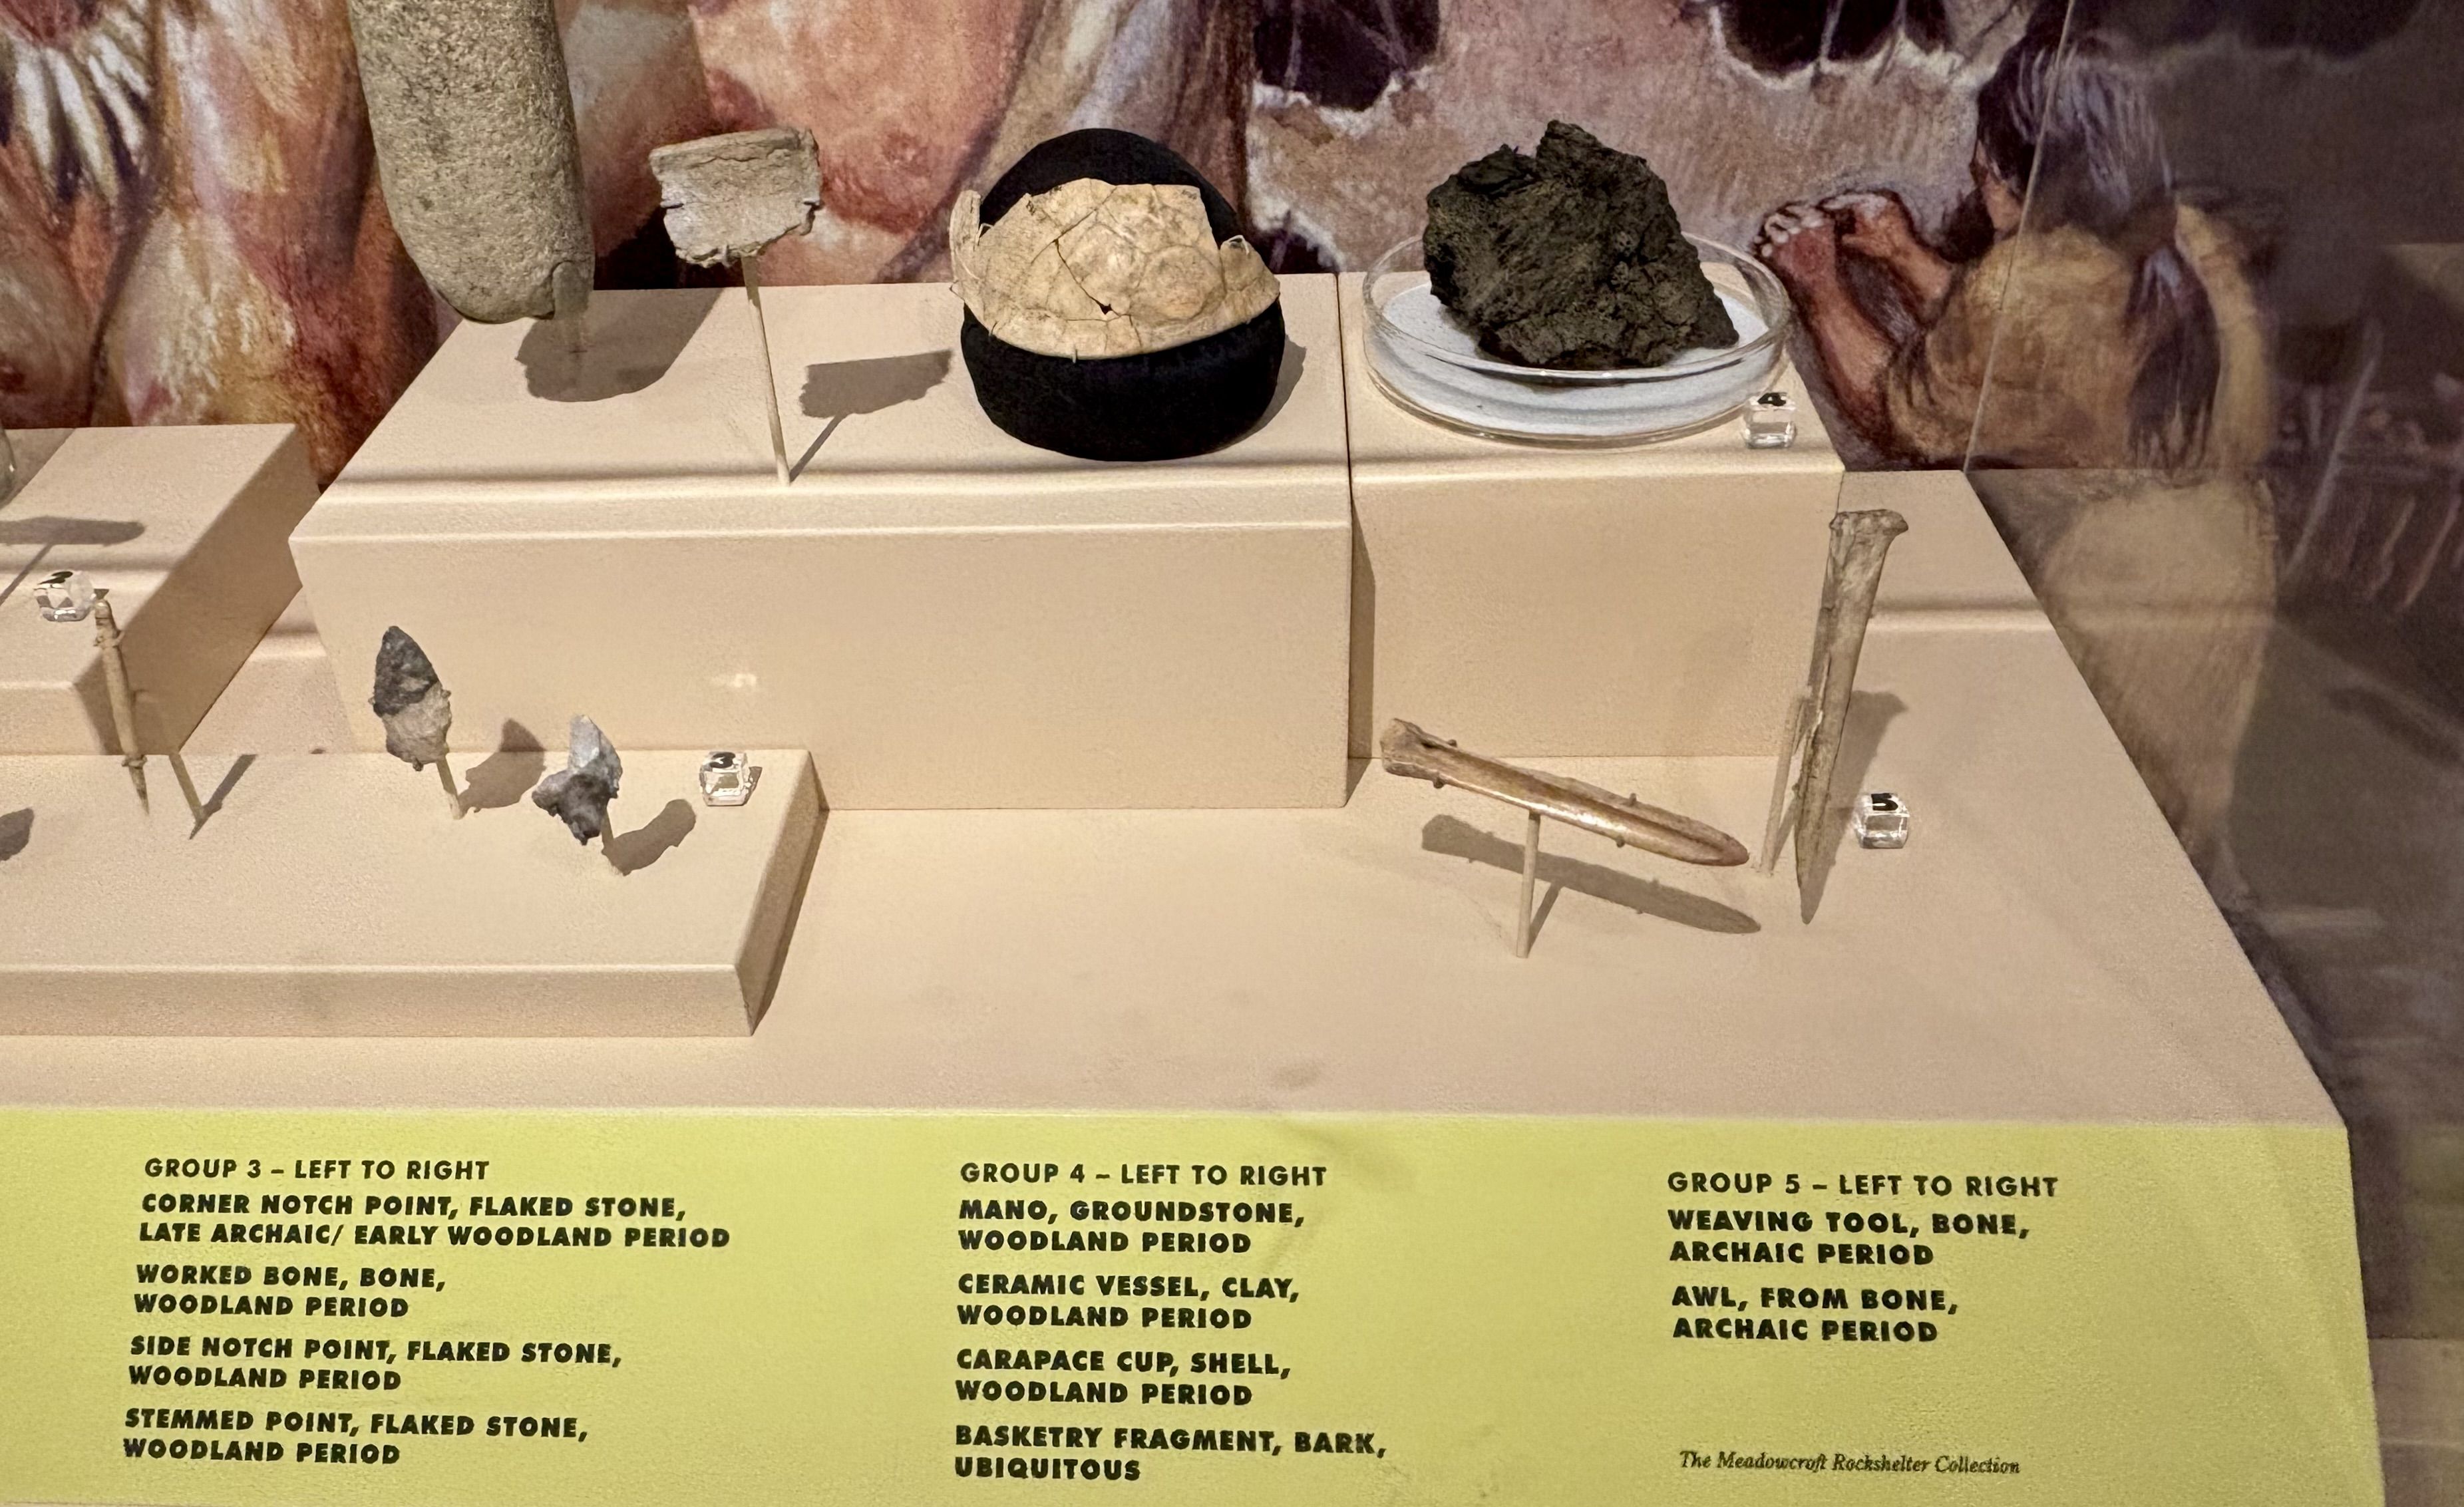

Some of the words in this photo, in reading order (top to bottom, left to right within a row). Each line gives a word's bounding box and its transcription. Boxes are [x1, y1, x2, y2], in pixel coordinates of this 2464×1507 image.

[1757, 392, 1787, 407] 4
[709, 752, 736, 768] 3
[1870, 792, 1898, 811] 5
[145, 1158, 237, 1178] GROUP
[248, 1160, 260, 1178] 3
[295, 1160, 351, 1178] LEFT
[362, 1160, 395, 1179] TO
[407, 1160, 489, 1180] RIGHT
[961, 1163, 1058, 1183] GROUP
[1070, 1164, 1085, 1183] 4
[1122, 1164, 1180, 1184] LEFT
[1192, 1165, 1227, 1185] TO
[1240, 1166, 1326, 1186] RIGHT
[1668, 1172, 1771, 1193] GROUP
[1786, 1174, 1800, 1194] 5
[1840, 1175, 1902, 1195] LEFT
[1914, 1176, 1952, 1196] TO
[1966, 1176, 2058, 1197] RIGHT
[142, 1194, 249, 1213] CORNER
[261, 1195, 352, 1214] NOTCH
[365, 1196, 458, 1220] POINT,
[470, 1197, 572, 1216] FLAKED
[585, 1198, 685, 1221] STONE,
[960, 1200, 1057, 1224] MANO,
[1071, 1200, 1304, 1228] GROUNDSTONE,
[140, 1222, 200, 1242] LATE
[211, 1224, 343, 1246] ARCHAIC/
[355, 1226, 438, 1245] EARLY
[448, 1226, 612, 1246] WOODLAND
[625, 1228, 729, 1248] PERIOD
[1668, 1210, 1813, 1232] WEAVING
[1826, 1212, 1918, 1238] TOOL,
[1932, 1214, 2029, 1239] BONE,
[958, 1230, 1129, 1251] WOODLAND
[1143, 1232, 1250, 1253] PERIOD
[1670, 1241, 1803, 1263] ARCHAIC
[1818, 1244, 1933, 1265] PERIOD
[136, 1264, 252, 1284] WORKED
[264, 1266, 347, 1290] BONE,
[360, 1267, 444, 1291] BONE,
[959, 1273, 1084, 1295] CERAMIC
[1096, 1275, 1209, 1301] VESSEL,
[1222, 1277, 1298, 1303] CLAY,
[134, 1293, 293, 1315] WOODLAND
[306, 1297, 408, 1317] PERIOD
[1672, 1286, 1747, 1311] AWL,
[1761, 1287, 1848, 1309] FROM
[1861, 1289, 1957, 1315] BONE,
[957, 1305, 1128, 1327] WOODLAND
[1143, 1307, 1251, 1329] PERIOD
[1673, 1318, 1807, 1340] ARCHAIC
[1822, 1321, 1937, 1342] PERIOD
[131, 1335, 190, 1355] SIDE
[202, 1337, 292, 1358] NOTCH
[305, 1339, 396, 1364] POINT,
[407, 1341, 510, 1361] FLAKED
[522, 1343, 621, 1367] STONE,
[957, 1349, 1104, 1371] CARAPACE
[1117, 1351, 1178, 1377] CUP,
[1190, 1353, 1290, 1379] SHELL,
[129, 1365, 287, 1388] WOODLAND
[299, 1369, 401, 1390] PERIOD
[956, 1380, 1127, 1403] WOODLAND
[1142, 1384, 1252, 1405] PERIOD
[125, 1408, 254, 1430] STEMMED
[265, 1411, 359, 1436] POINT,
[371, 1414, 474, 1435] FLAKED
[486, 1417, 587, 1442] STONE,
[123, 1438, 283, 1461] WOODLAND
[297, 1442, 399, 1464] PERIOD
[956, 1425, 1102, 1448] BASKETRY
[1115, 1428, 1281, 1456] FRAGMENT,
[1295, 1432, 1385, 1458] BARK,
[955, 1457, 1140, 1481] UBIQUITOUS
[1679, 1450, 1711, 1468] The
[1717, 1451, 1827, 1473] Meadowcroft
[1832, 1454, 1931, 1472] Rockshelter
[1934, 1455, 2020, 1474] Collection
